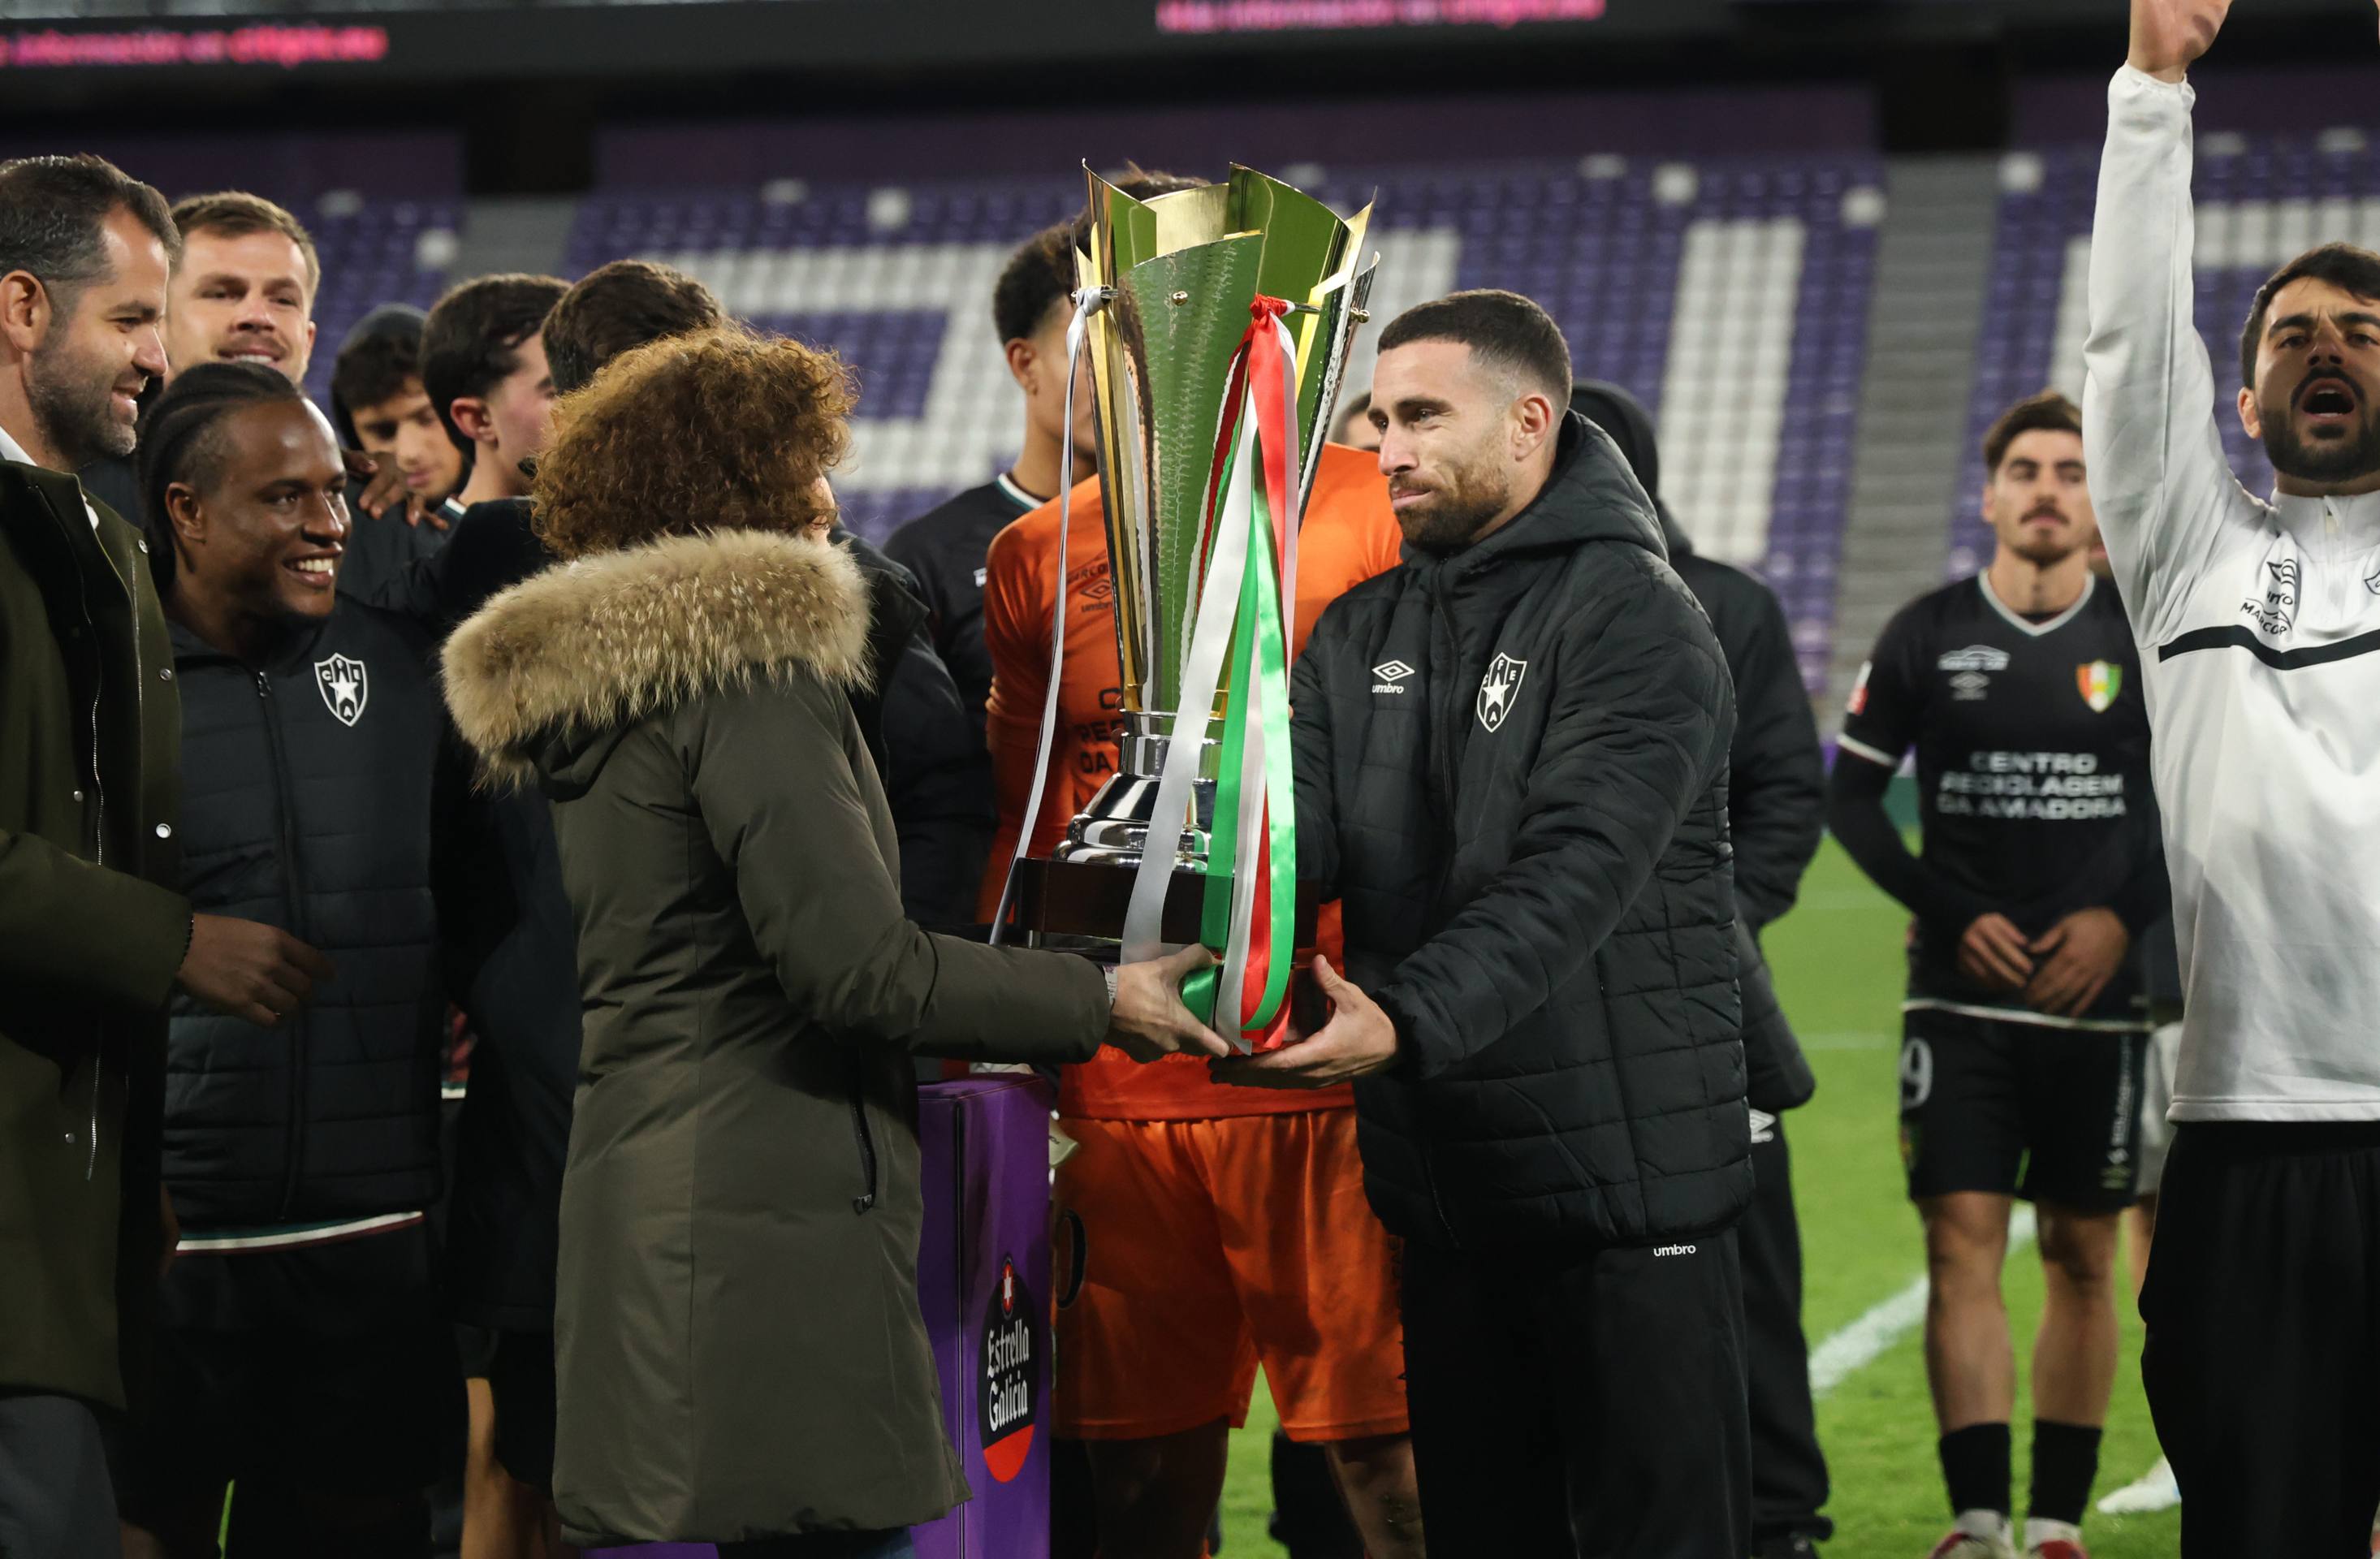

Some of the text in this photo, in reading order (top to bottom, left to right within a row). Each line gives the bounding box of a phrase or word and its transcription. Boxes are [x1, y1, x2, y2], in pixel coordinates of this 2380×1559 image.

[1371, 682, 1405, 694] umbro
[1969, 750, 2098, 775] CENTRO
[1653, 1243, 1696, 1257] umbro
[987, 1318, 1030, 1380] Estrella
[988, 1370, 1028, 1432] Galicia
